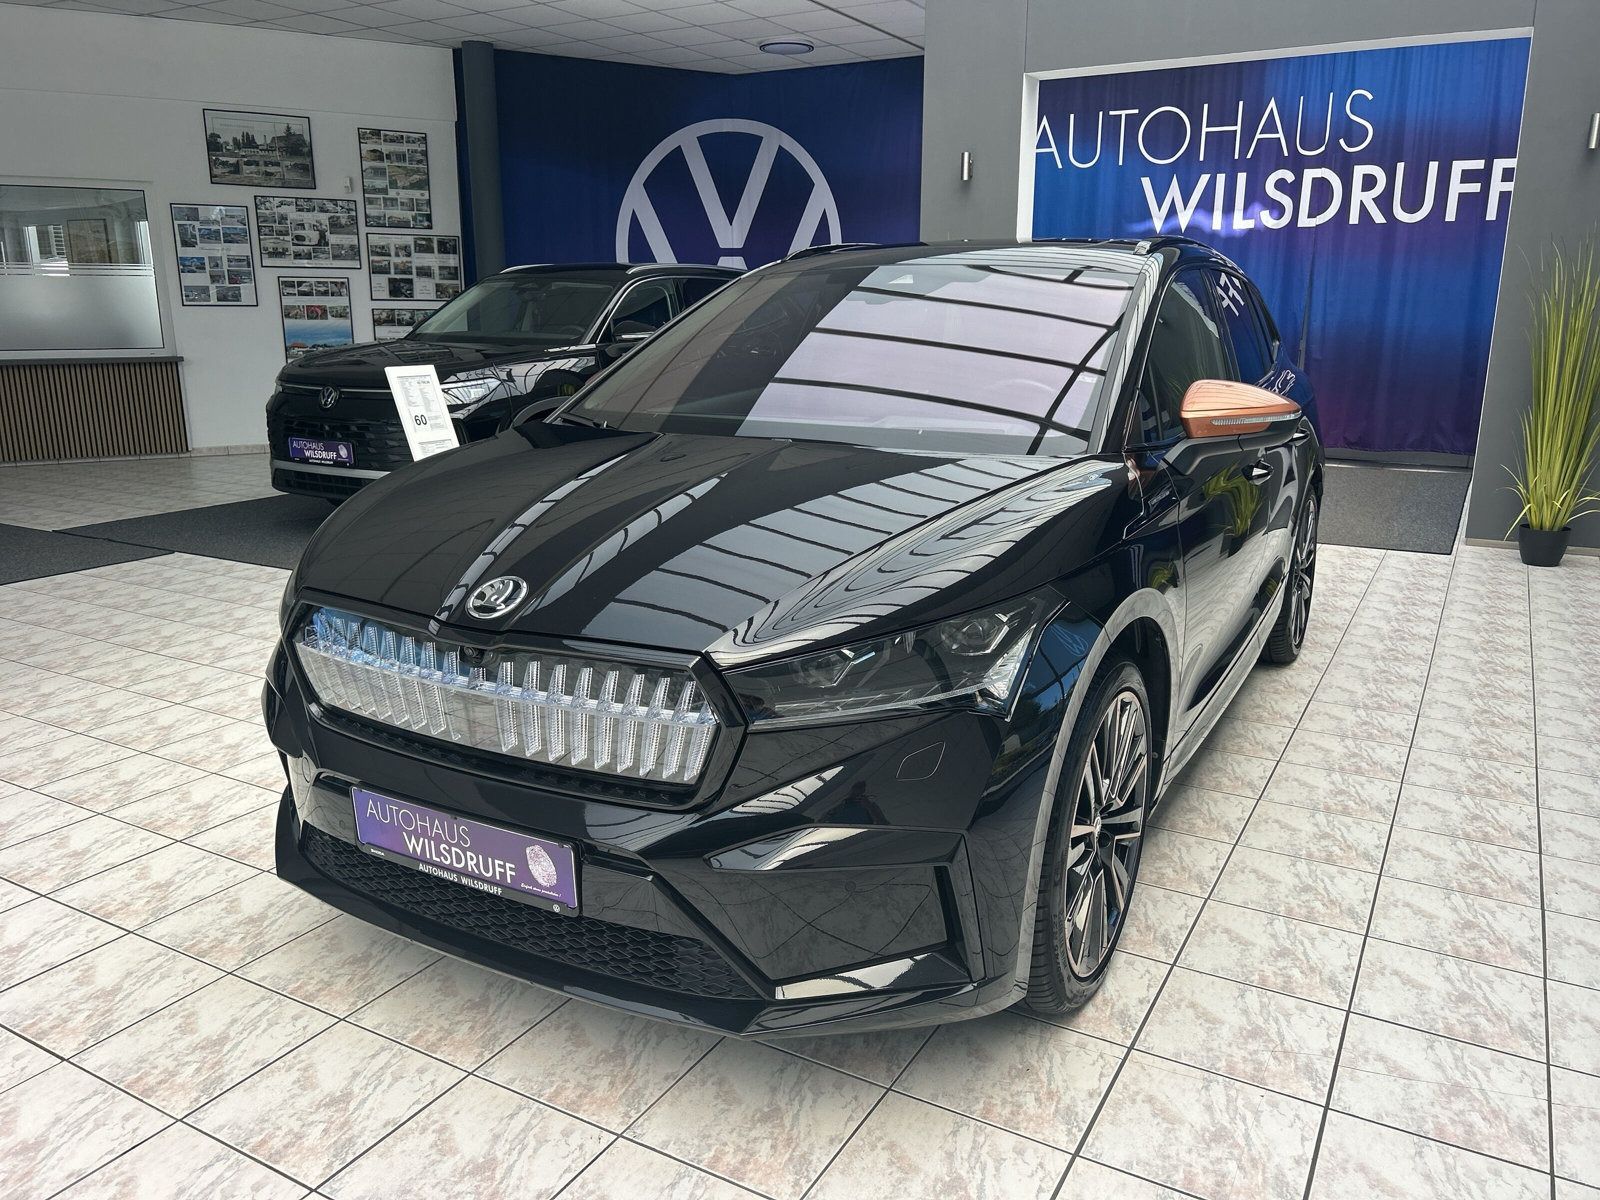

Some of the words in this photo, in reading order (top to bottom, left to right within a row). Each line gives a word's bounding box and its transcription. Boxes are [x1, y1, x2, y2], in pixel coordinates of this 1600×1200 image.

[1035, 88, 1375, 169] AUTOHAUS
[1141, 157, 1517, 233] WILSDRUFF
[413, 414, 427, 426] 60
[292, 440, 325, 451] AUTOHAUS
[304, 449, 337, 460] WILSDRUFF
[366, 798, 471, 848] AUTOHAUS
[402, 831, 517, 884] WILSDRUFF
[418, 863, 458, 882] AUTOHAUS
[460, 875, 503, 896] WILSDRUFF
